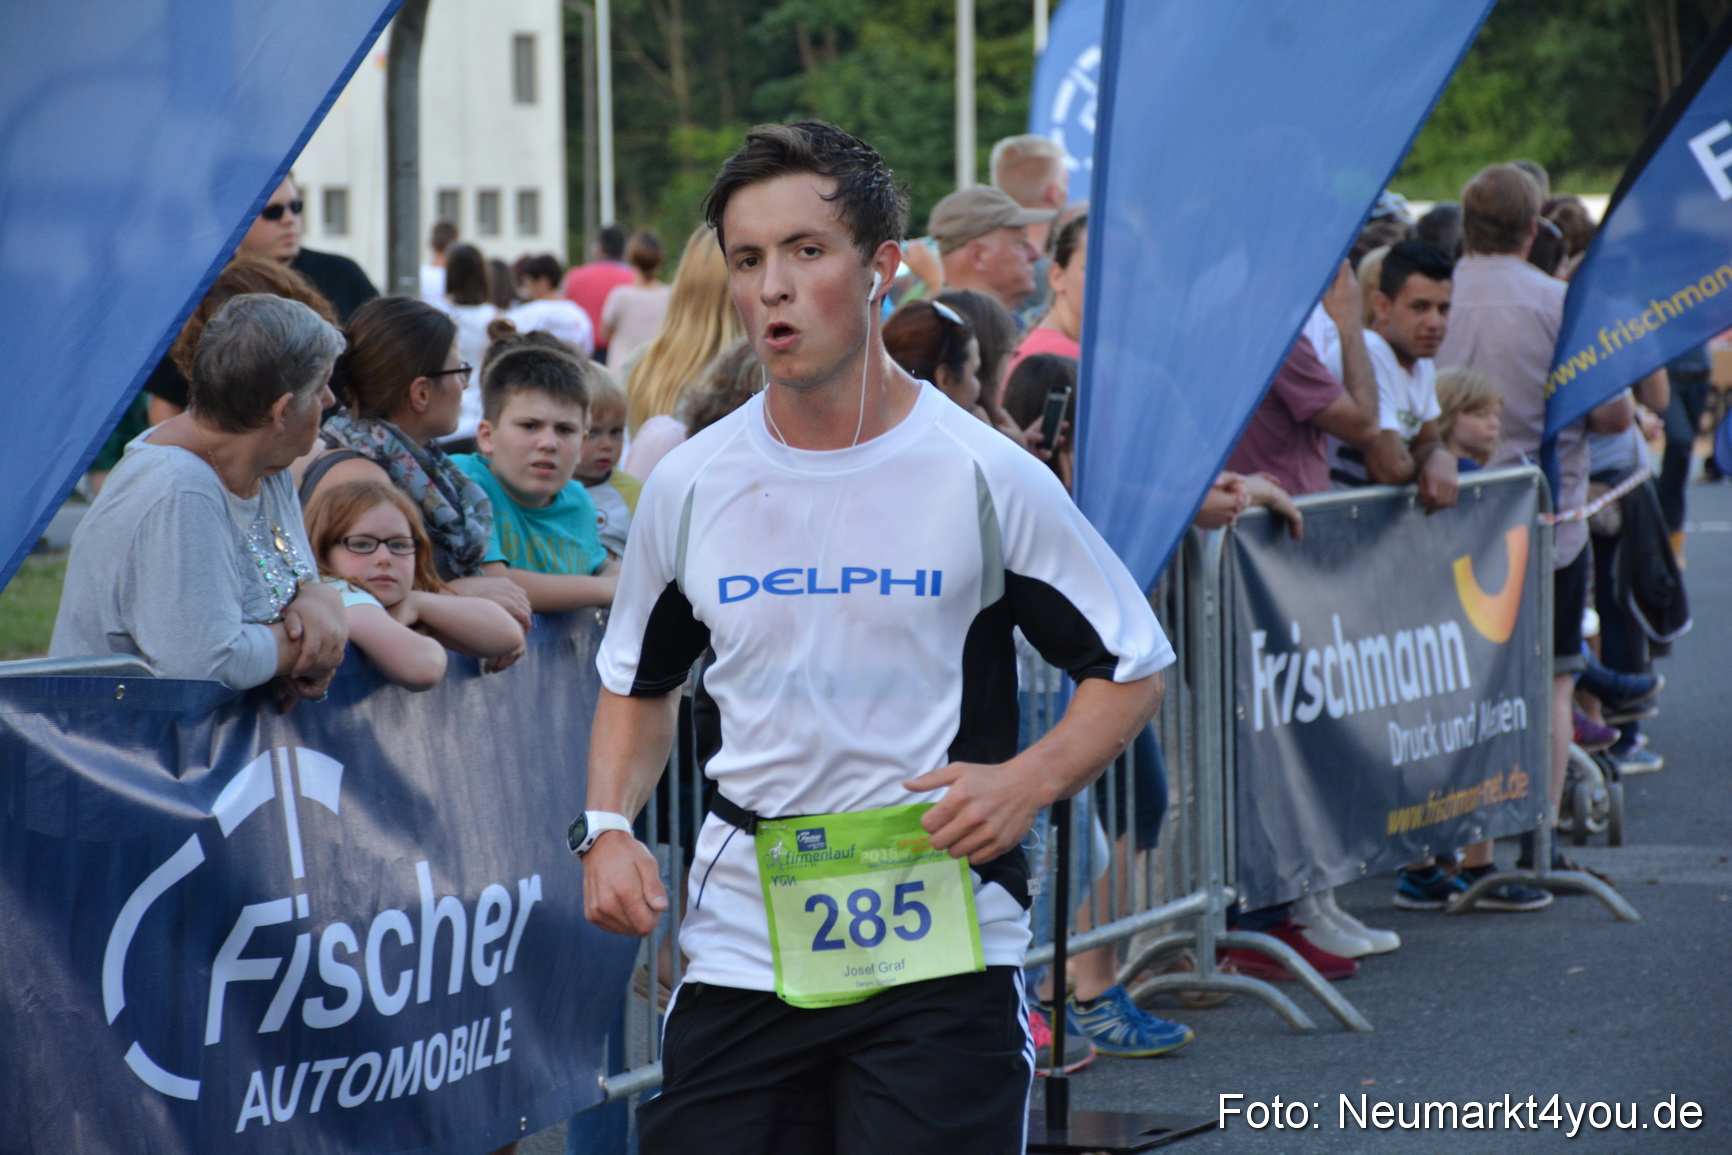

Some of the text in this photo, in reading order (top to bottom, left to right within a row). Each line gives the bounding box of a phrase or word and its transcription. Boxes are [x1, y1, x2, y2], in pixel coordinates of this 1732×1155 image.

[718, 566, 943, 604] DELPHI
[1251, 613, 1471, 732] Frischmann
[1388, 711, 1440, 767] Druck
[1440, 701, 1477, 753] und
[785, 843, 857, 865] firmenlauf
[804, 880, 933, 952] 285
[204, 861, 543, 1046] Fischer
[843, 959, 906, 977] Josef Graf
[235, 1007, 512, 1134] AUTOMOBILE
